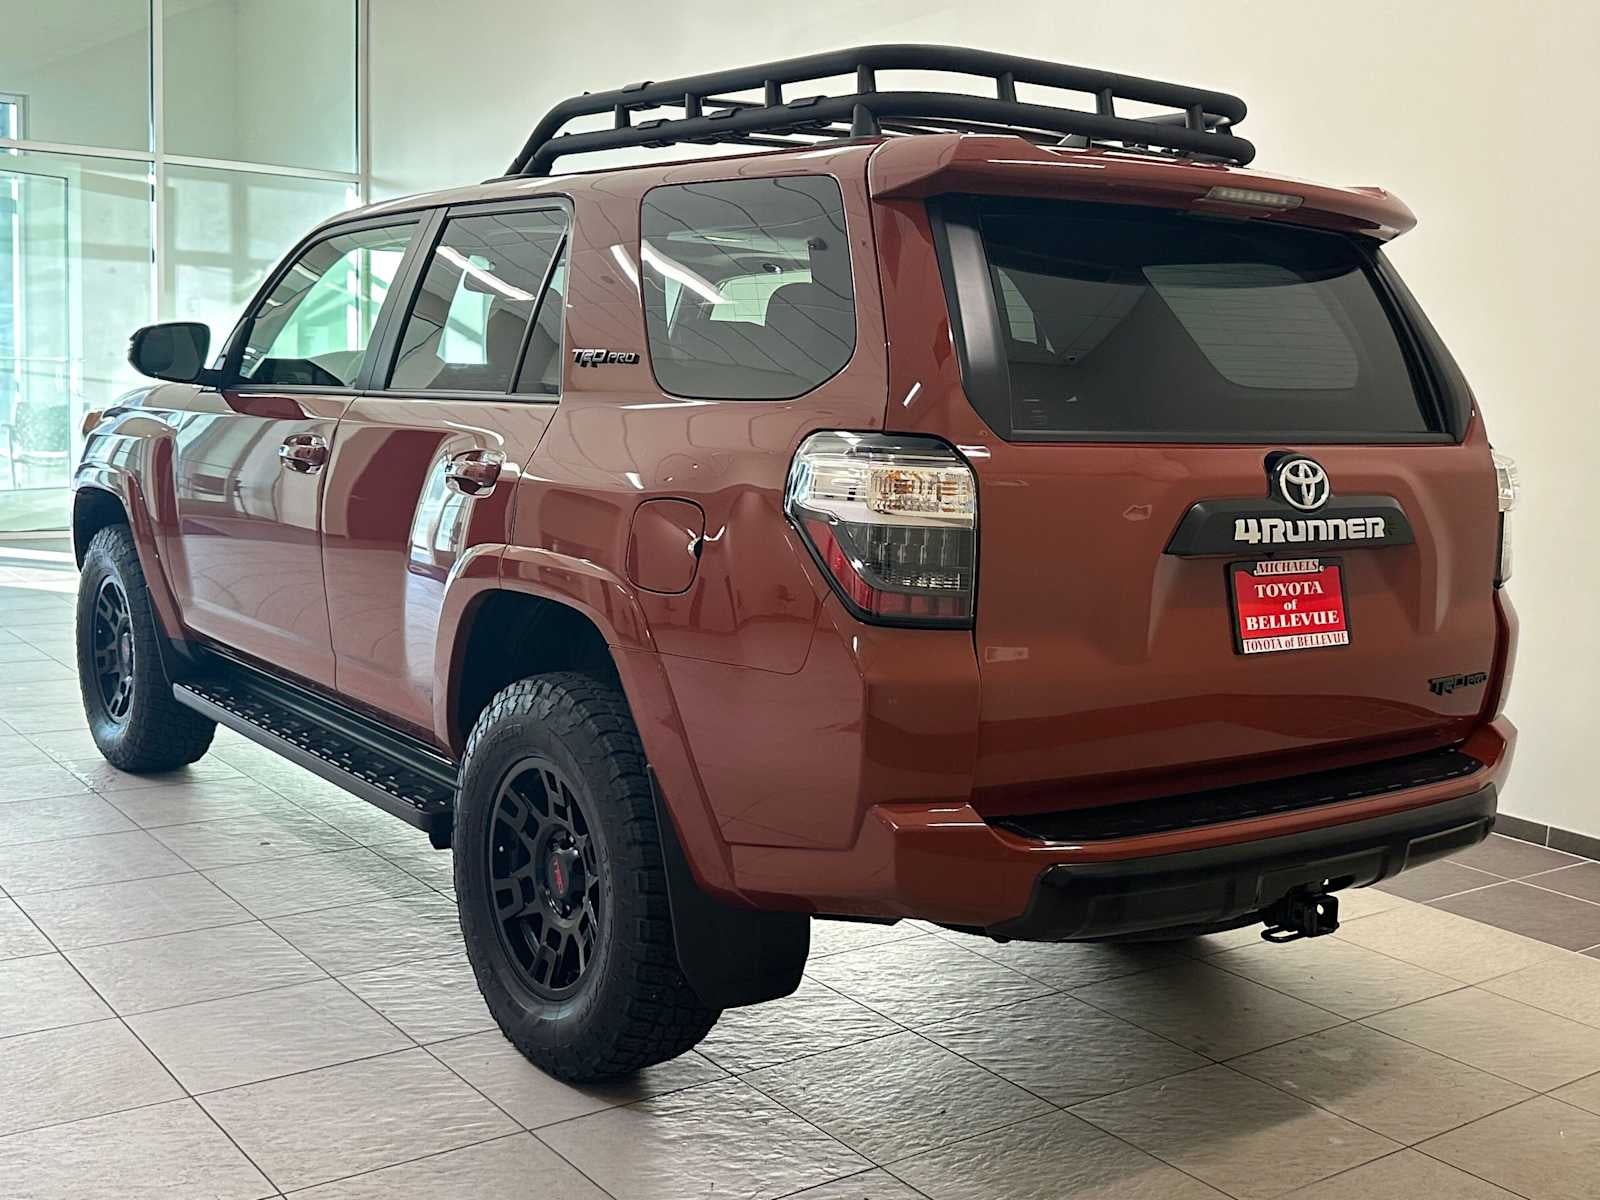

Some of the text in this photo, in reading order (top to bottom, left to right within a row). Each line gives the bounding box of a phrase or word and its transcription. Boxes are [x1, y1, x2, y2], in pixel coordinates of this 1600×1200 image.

[572, 348, 640, 368] TRD PRO
[1257, 560, 1318, 574] MICHAELS
[1254, 581, 1324, 598] TOYOTA
[1283, 598, 1298, 611] of
[1246, 610, 1340, 631] BELLEVUE
[1244, 632, 1346, 652] TOYOTA of BELLEVUE
